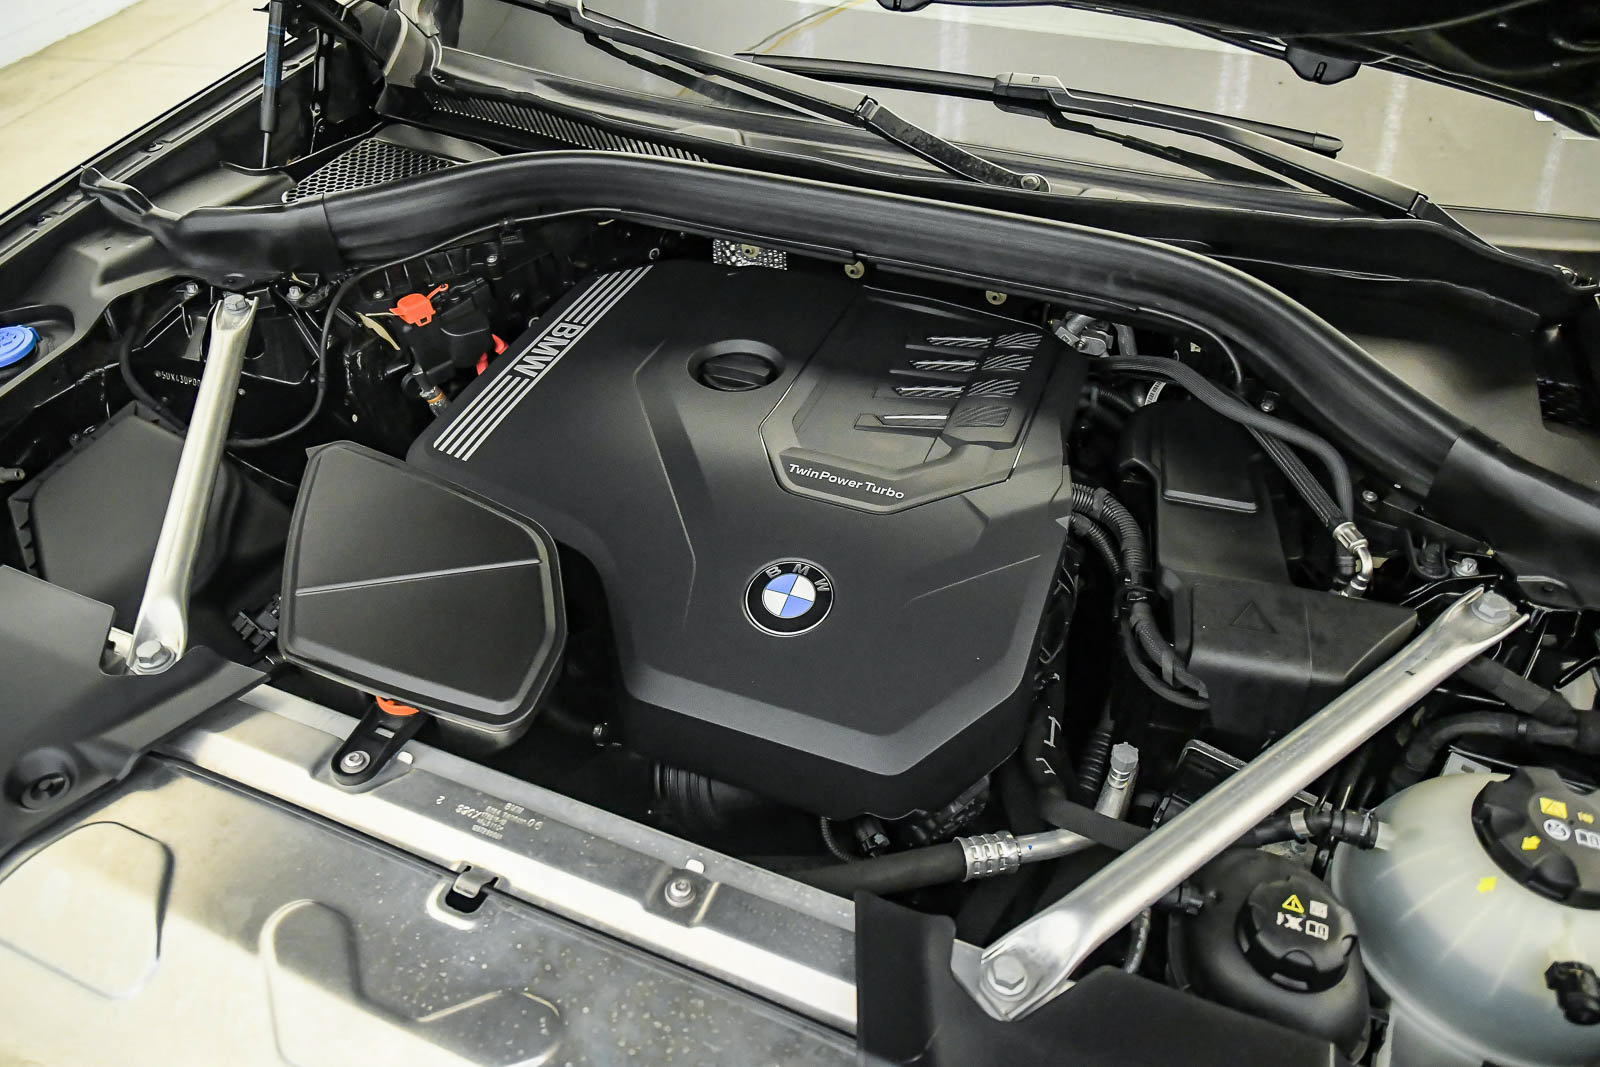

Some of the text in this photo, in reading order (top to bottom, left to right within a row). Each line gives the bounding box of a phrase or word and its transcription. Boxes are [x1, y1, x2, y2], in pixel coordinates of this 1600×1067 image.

[513, 322, 585, 378] BMW
[789, 463, 905, 499] TwinPower Turbo
[765, 563, 830, 592] BMW
